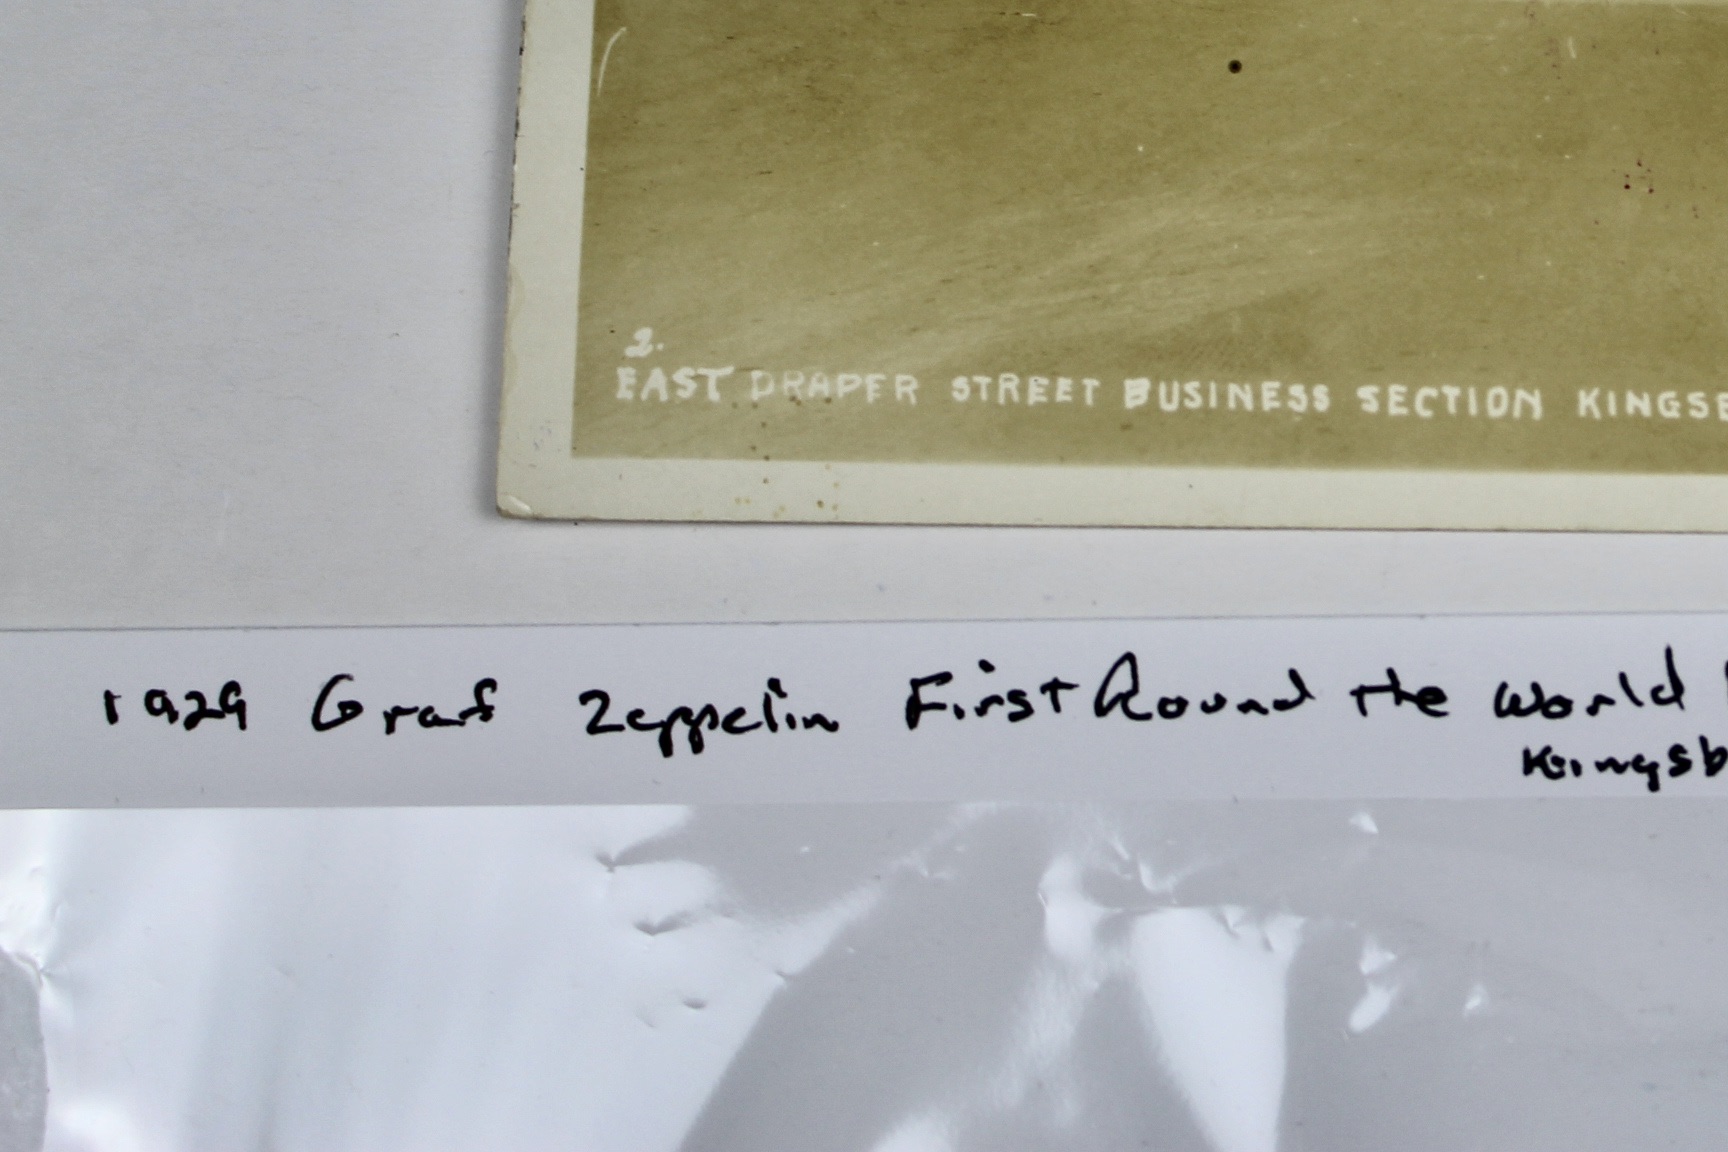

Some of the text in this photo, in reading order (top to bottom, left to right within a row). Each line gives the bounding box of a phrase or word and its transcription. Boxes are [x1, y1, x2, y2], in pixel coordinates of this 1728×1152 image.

[615, 364, 736, 403] EAST
[748, 369, 920, 406] DRAPER
[950, 372, 1102, 407] STREET
[1122, 375, 1332, 414] BUSINESS
[1355, 383, 1544, 421] SECTION
[103, 679, 248, 732] 1929
[310, 672, 499, 736] Graf
[577, 676, 841, 759] Zeppelin
[904, 658, 1080, 732] First
[1349, 667, 1450, 718] the
